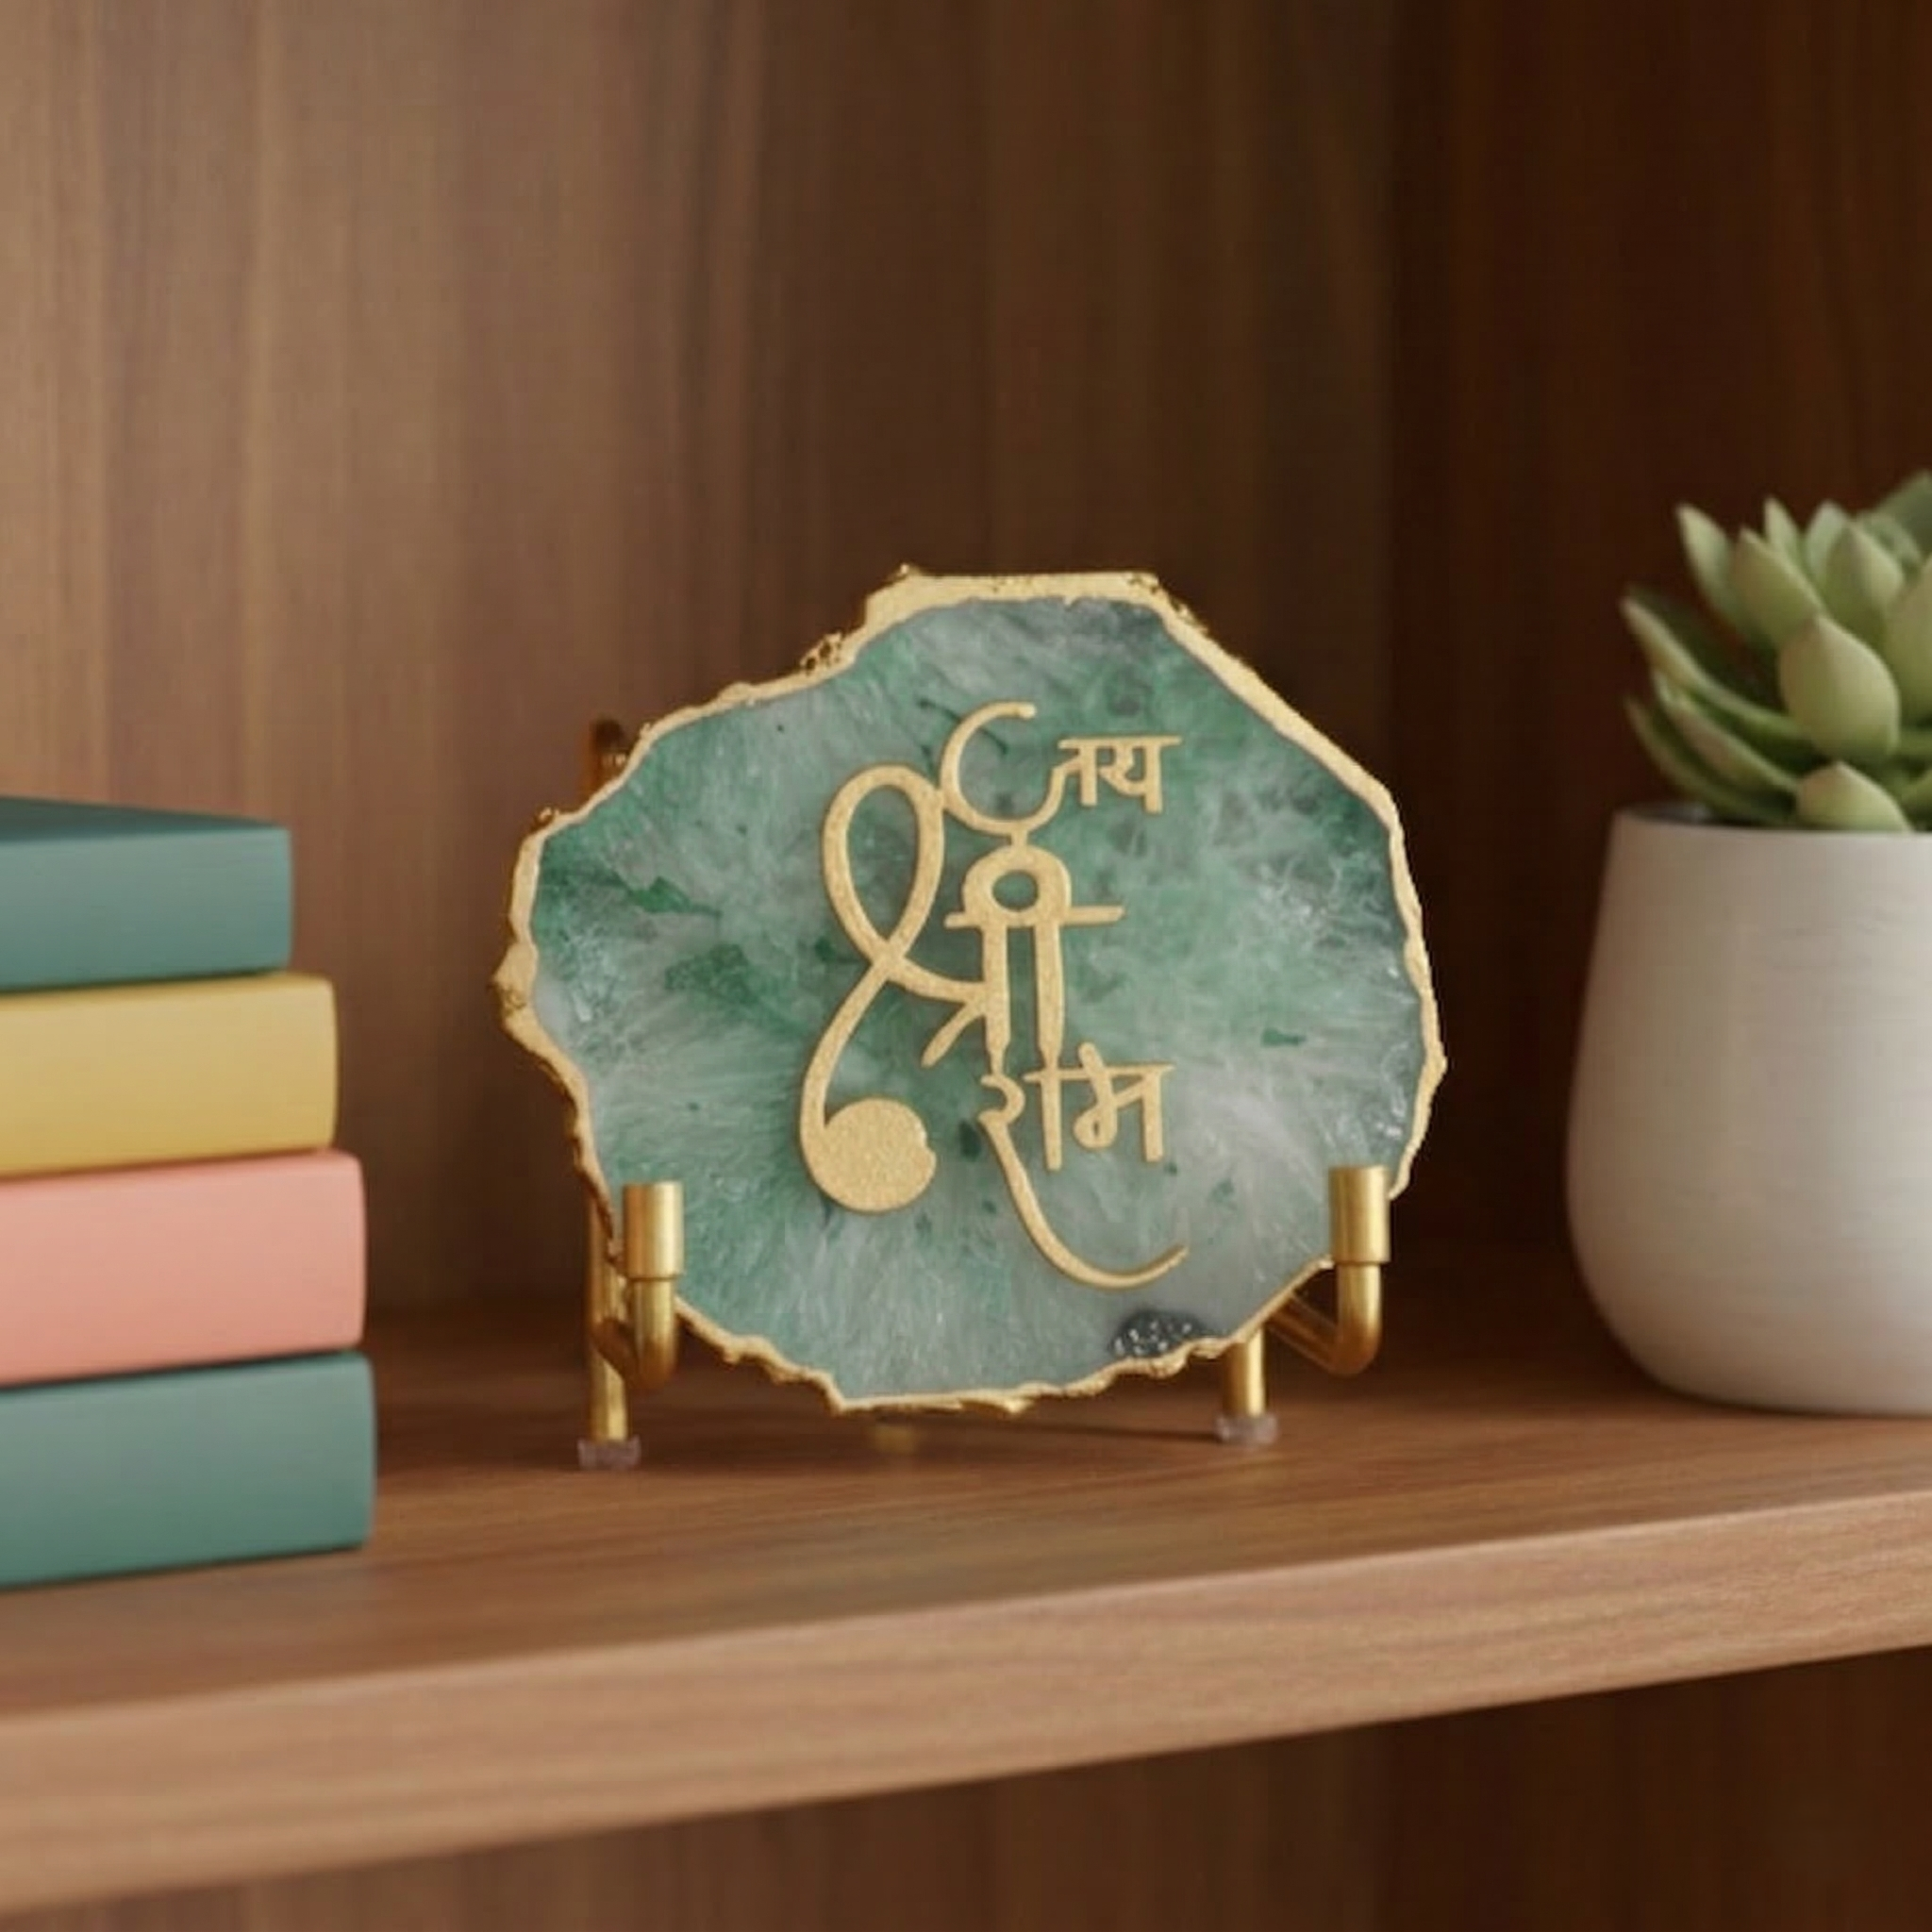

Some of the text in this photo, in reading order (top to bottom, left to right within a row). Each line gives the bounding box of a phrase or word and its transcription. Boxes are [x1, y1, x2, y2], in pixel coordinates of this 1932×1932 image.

[941, 701, 1181, 835] जय
[800, 764, 1124, 1213] श्री
[977, 1042, 1187, 1289] राम
